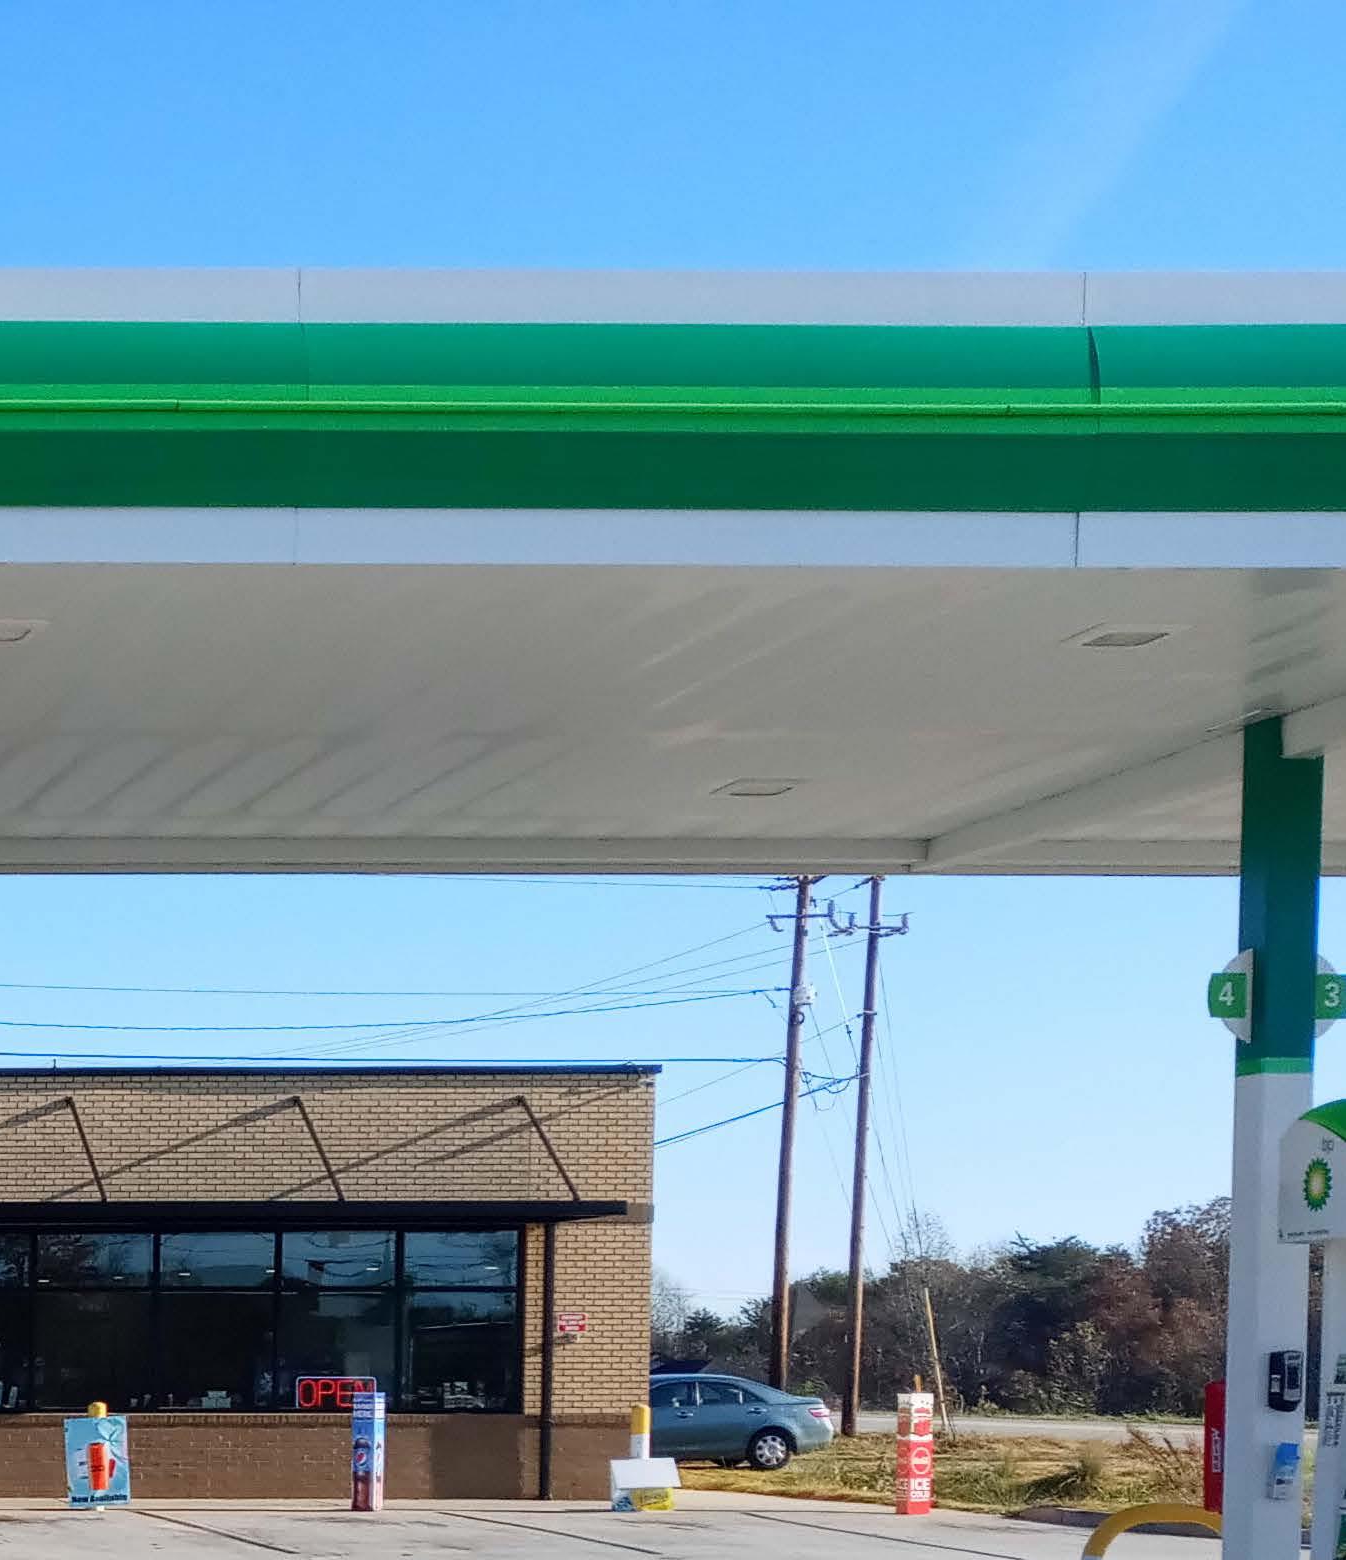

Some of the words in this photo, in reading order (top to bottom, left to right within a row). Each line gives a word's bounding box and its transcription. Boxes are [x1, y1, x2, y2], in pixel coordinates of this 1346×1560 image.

[1218, 981, 1235, 1007] 4
[1323, 982, 1341, 1008] 3
[910, 1477, 931, 1491] ICE
